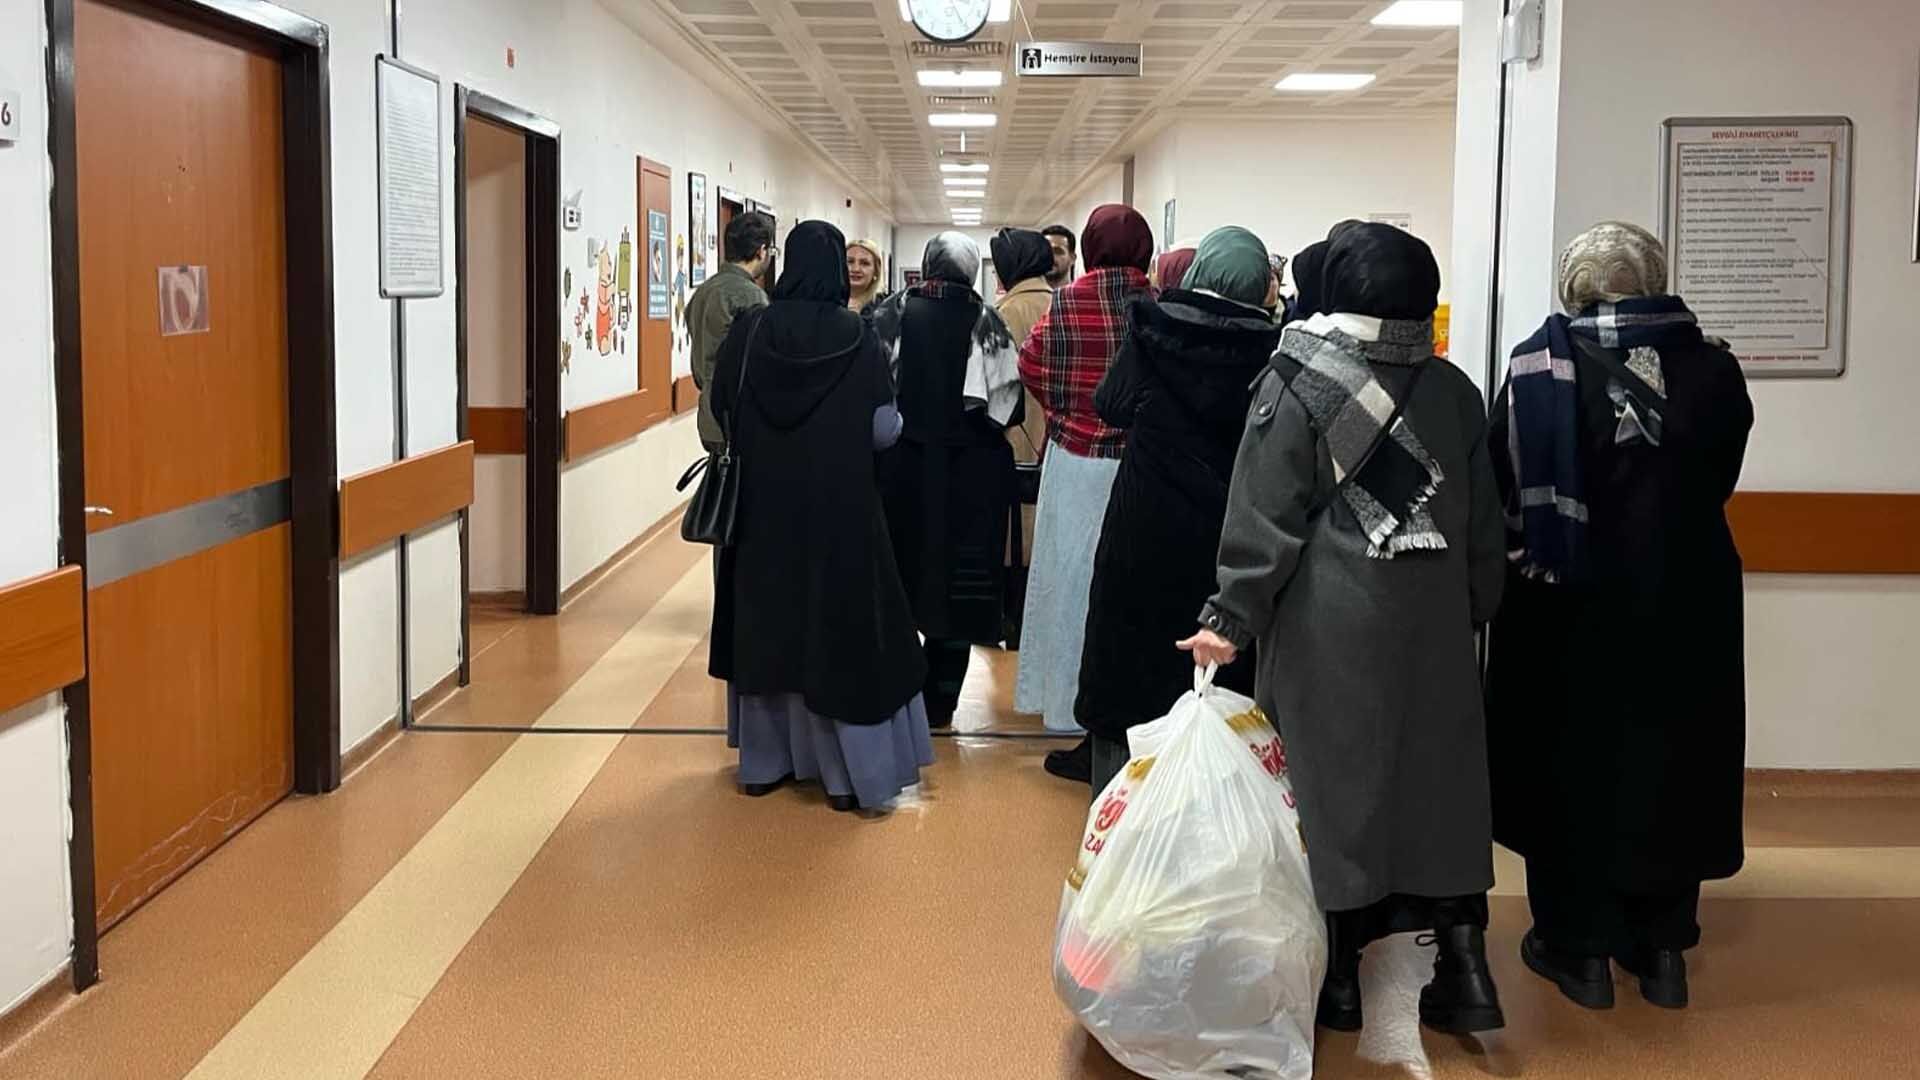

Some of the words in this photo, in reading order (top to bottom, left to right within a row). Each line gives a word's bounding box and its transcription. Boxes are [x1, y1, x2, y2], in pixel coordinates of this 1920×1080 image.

[1044, 53, 1087, 66] Hemşire
[1089, 51, 1138, 66] İstasyonu
[1, 101, 12, 127] 6
